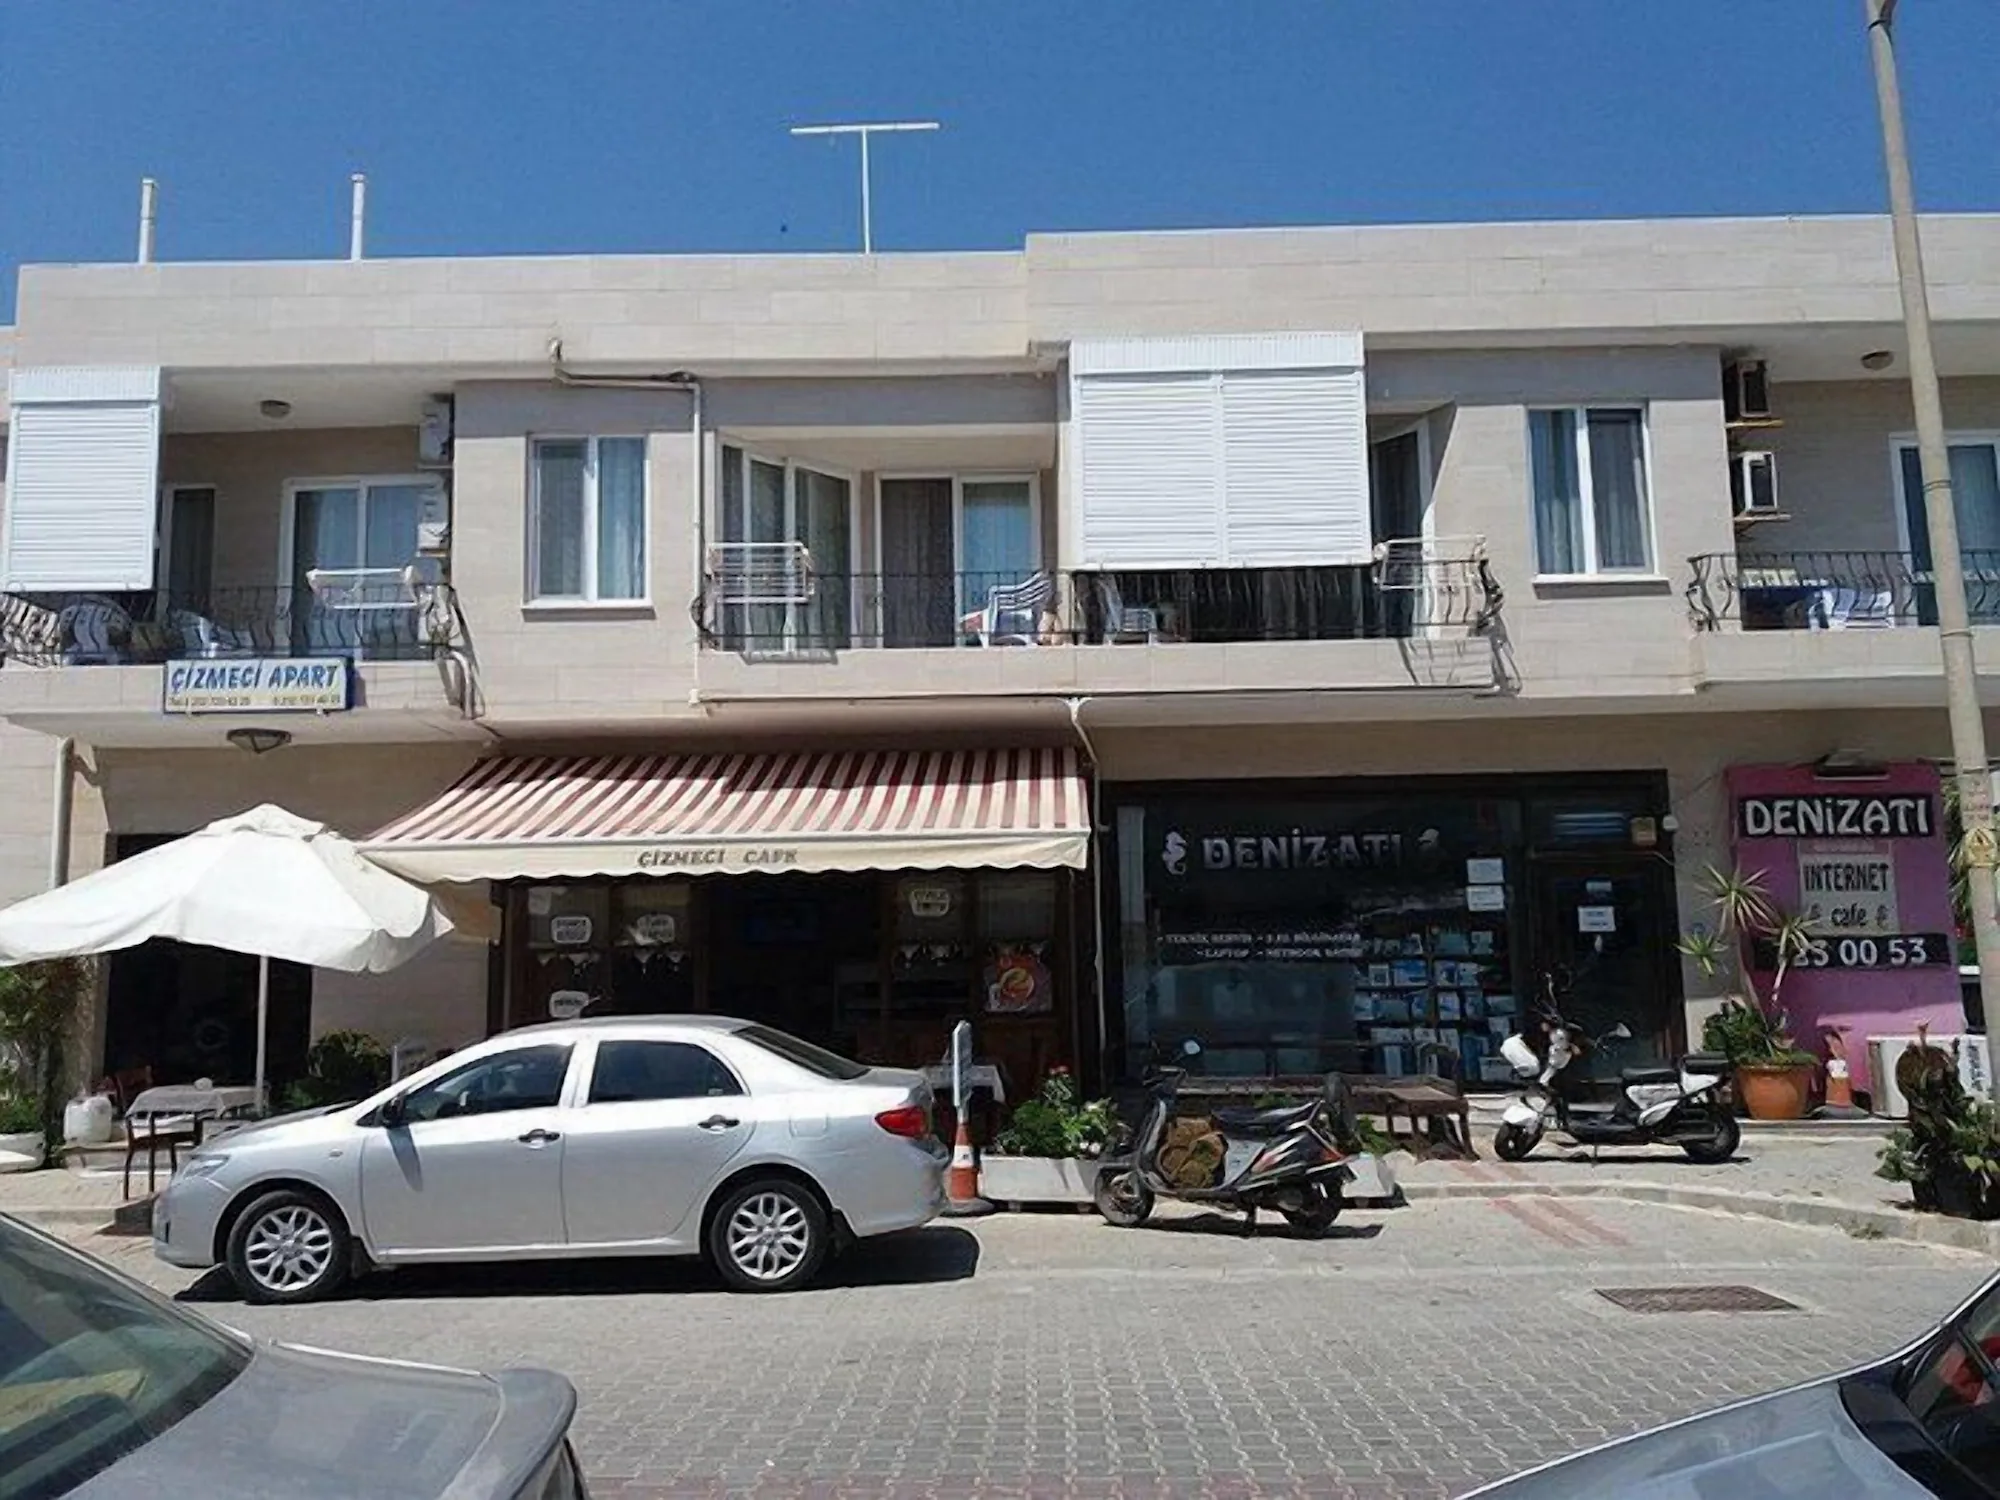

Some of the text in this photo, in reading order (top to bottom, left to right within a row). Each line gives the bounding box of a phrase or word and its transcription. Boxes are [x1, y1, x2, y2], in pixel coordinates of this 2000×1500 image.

[269, 665, 338, 689] APART
[1745, 797, 1929, 836] DENİZATI
[1803, 862, 1889, 892] INTERNET
[1831, 903, 1867, 928] cafe
[1839, 939, 1878, 966] 00
[1888, 937, 1927, 965] 53
